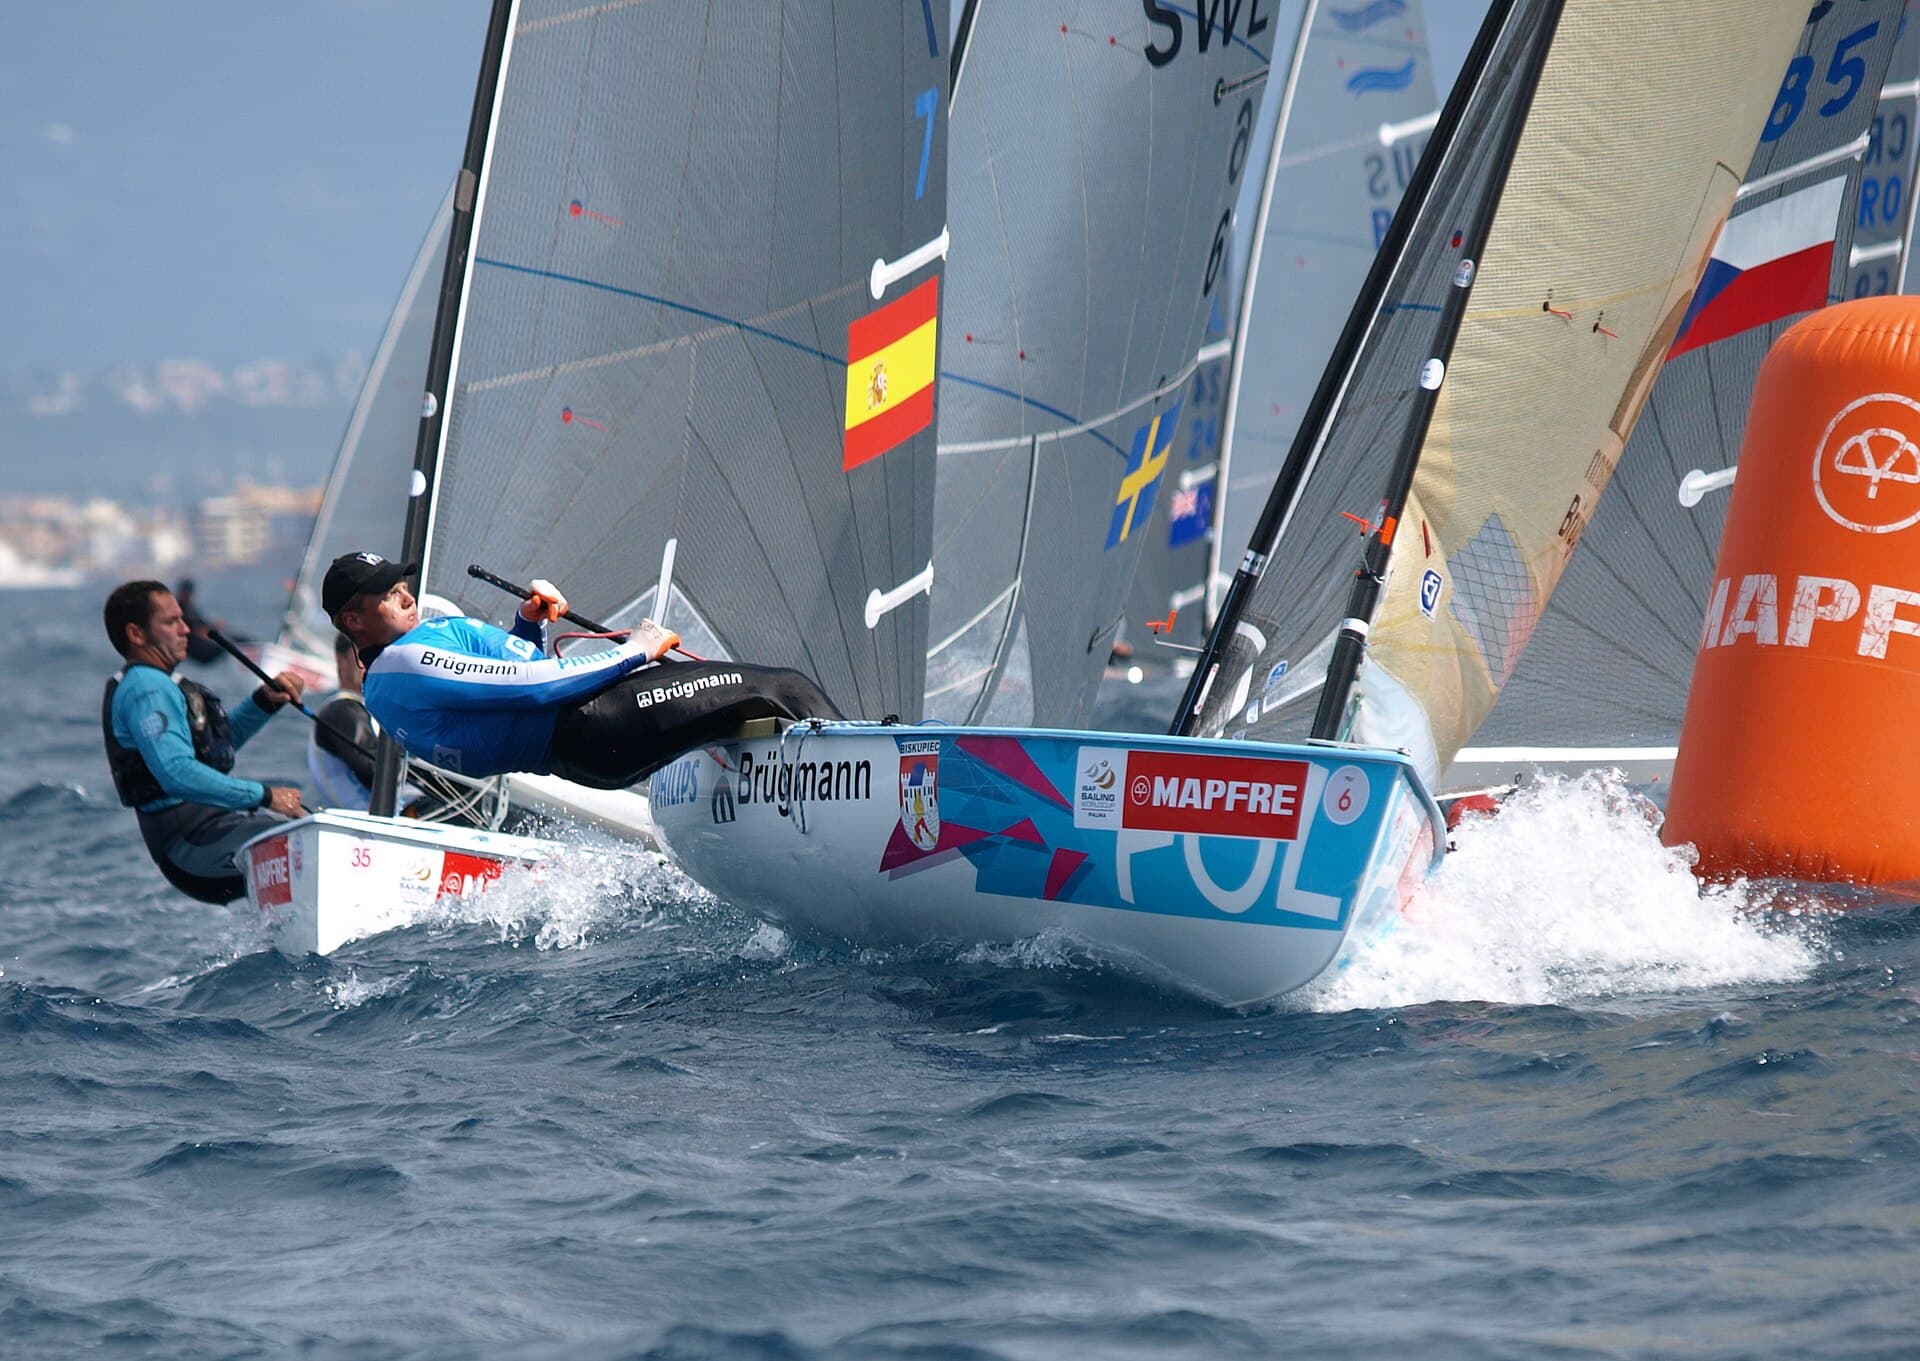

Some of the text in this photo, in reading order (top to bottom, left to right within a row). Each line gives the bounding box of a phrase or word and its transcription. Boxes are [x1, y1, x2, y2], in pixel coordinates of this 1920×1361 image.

[1760, 20, 1880, 143] 85
[914, 85, 939, 201] 7
[420, 651, 518, 676] Brügmann
[653, 672, 743, 703] Brügmann
[900, 742, 940, 754] BISKUPIEC
[737, 751, 872, 817] Brügmann
[1081, 792, 1116, 802] SAILING
[1151, 775, 1298, 817] MAPFRE
[1338, 788, 1352, 812] 6
[351, 847, 372, 868] 35
